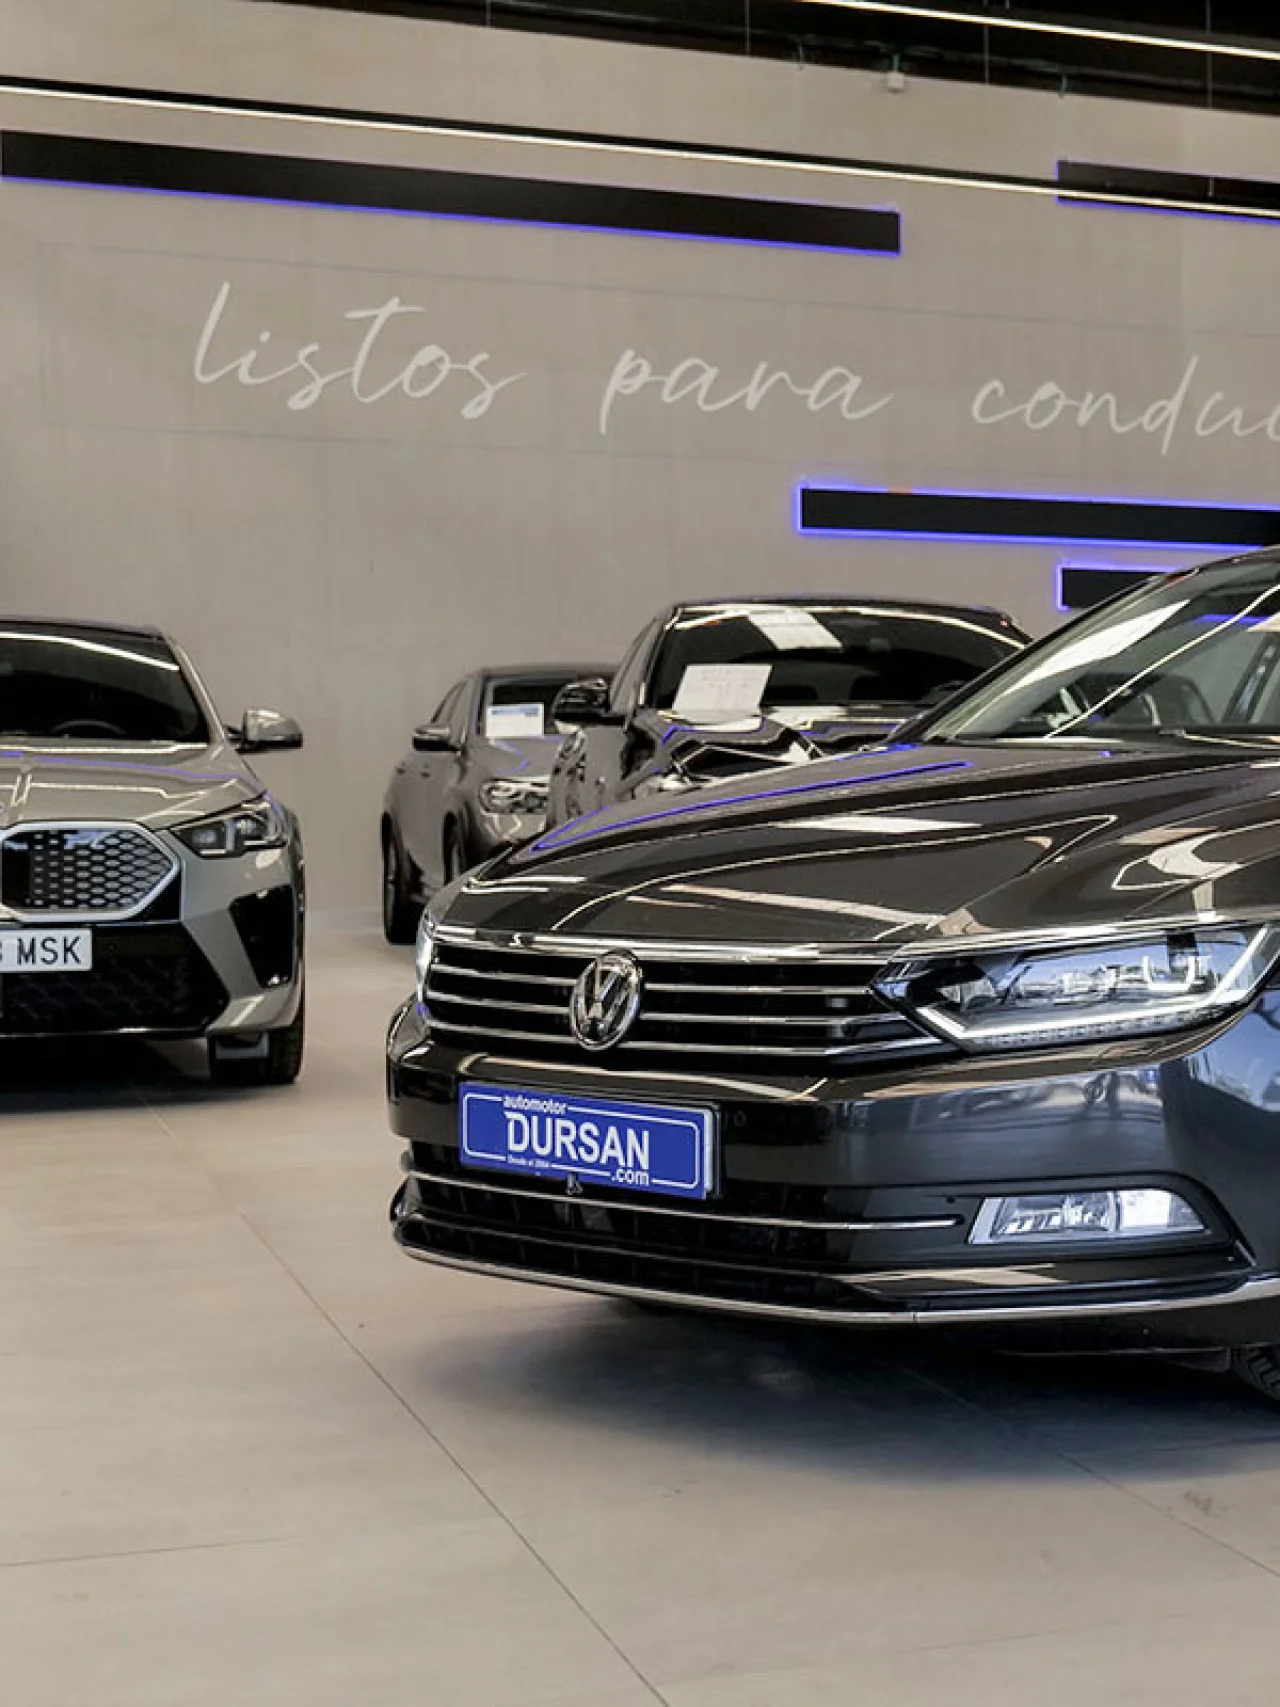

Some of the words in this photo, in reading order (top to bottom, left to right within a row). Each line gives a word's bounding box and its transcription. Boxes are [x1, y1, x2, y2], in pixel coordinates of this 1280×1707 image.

[194, 281, 526, 419] listos
[600, 349, 895, 435] para
[17, 936, 82, 965] MSK
[503, 1094, 567, 1115] automotor
[504, 1111, 650, 1170] DURSAN
[611, 1166, 650, 1186] .com
